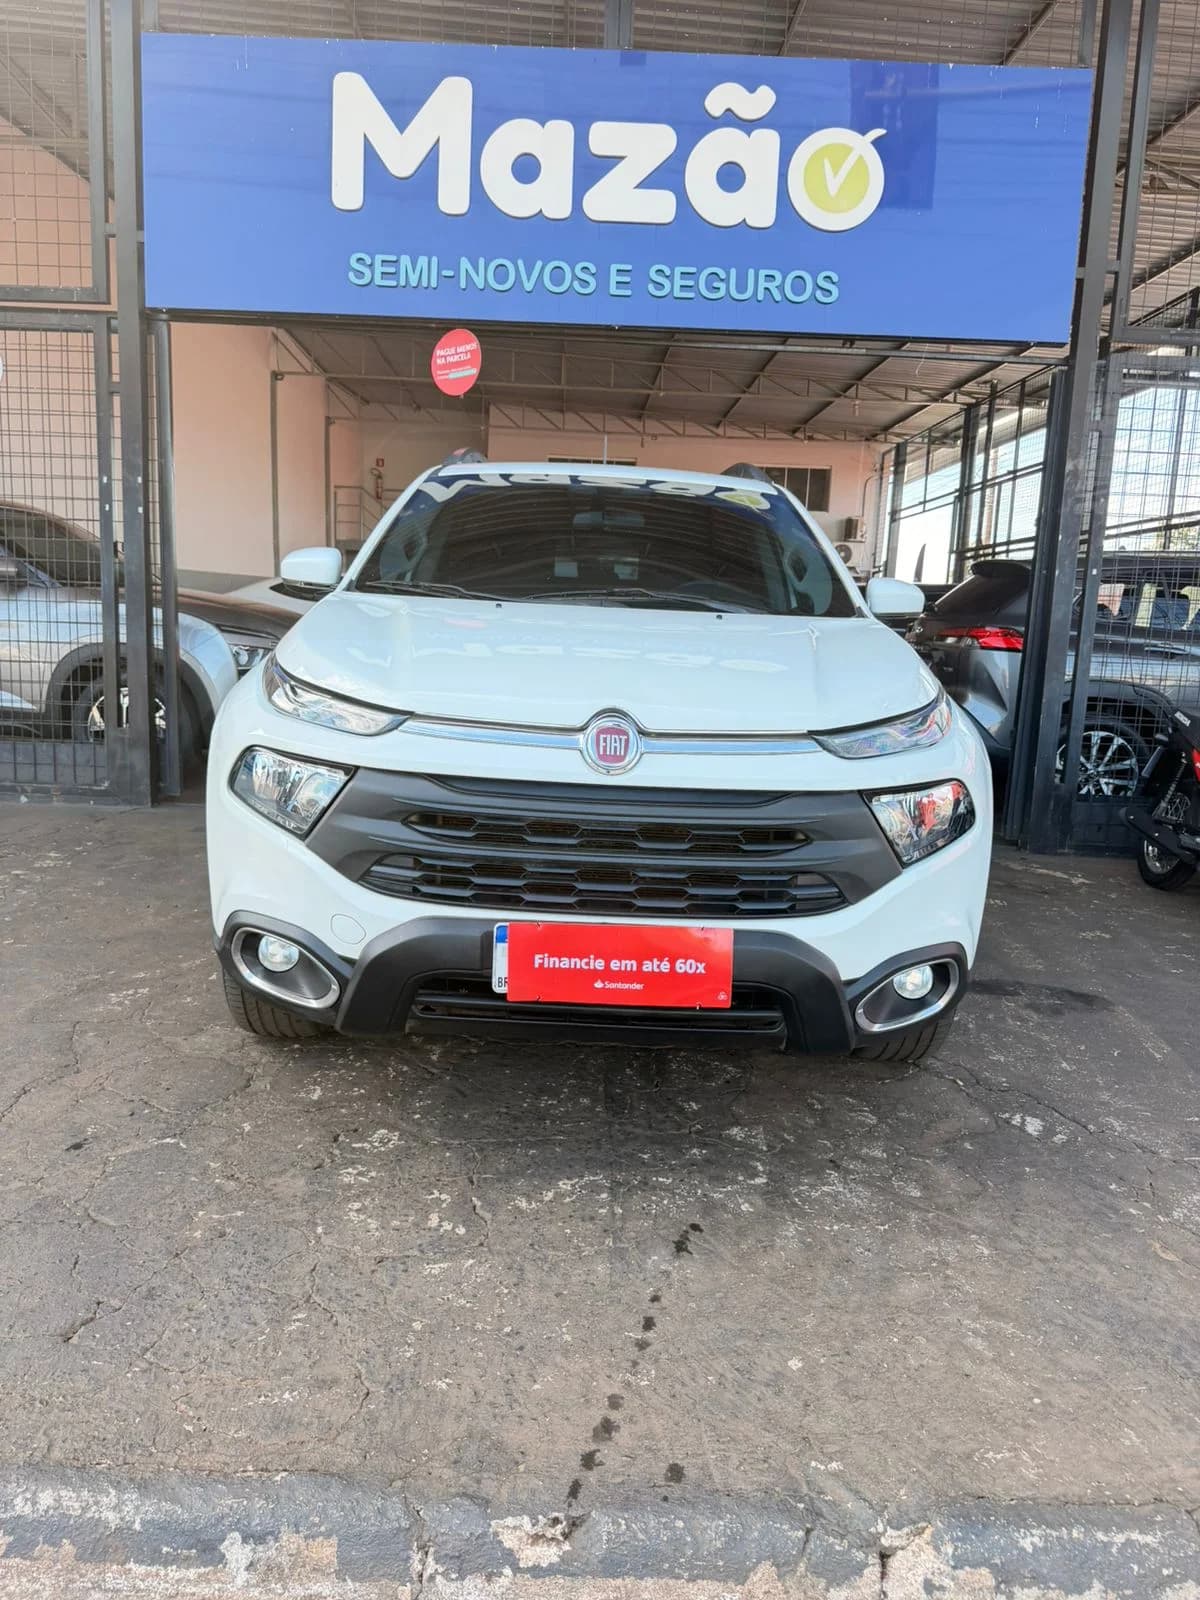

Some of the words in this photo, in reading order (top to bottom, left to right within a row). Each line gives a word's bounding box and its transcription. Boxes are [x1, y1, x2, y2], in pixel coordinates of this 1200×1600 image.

[331, 72, 887, 232] Mazão
[347, 252, 597, 296] SEMI-NOVOS
[608, 263, 633, 297] E
[647, 264, 840, 304] SEGUROS
[436, 356, 446, 365] NA
[446, 352, 472, 364] PARCELA
[599, 734, 628, 756] FIAT
[533, 953, 605, 970] Financie
[610, 959, 638, 972] em
[642, 956, 670, 973] até
[675, 959, 706, 974] 60x
[604, 980, 645, 991] Santander
